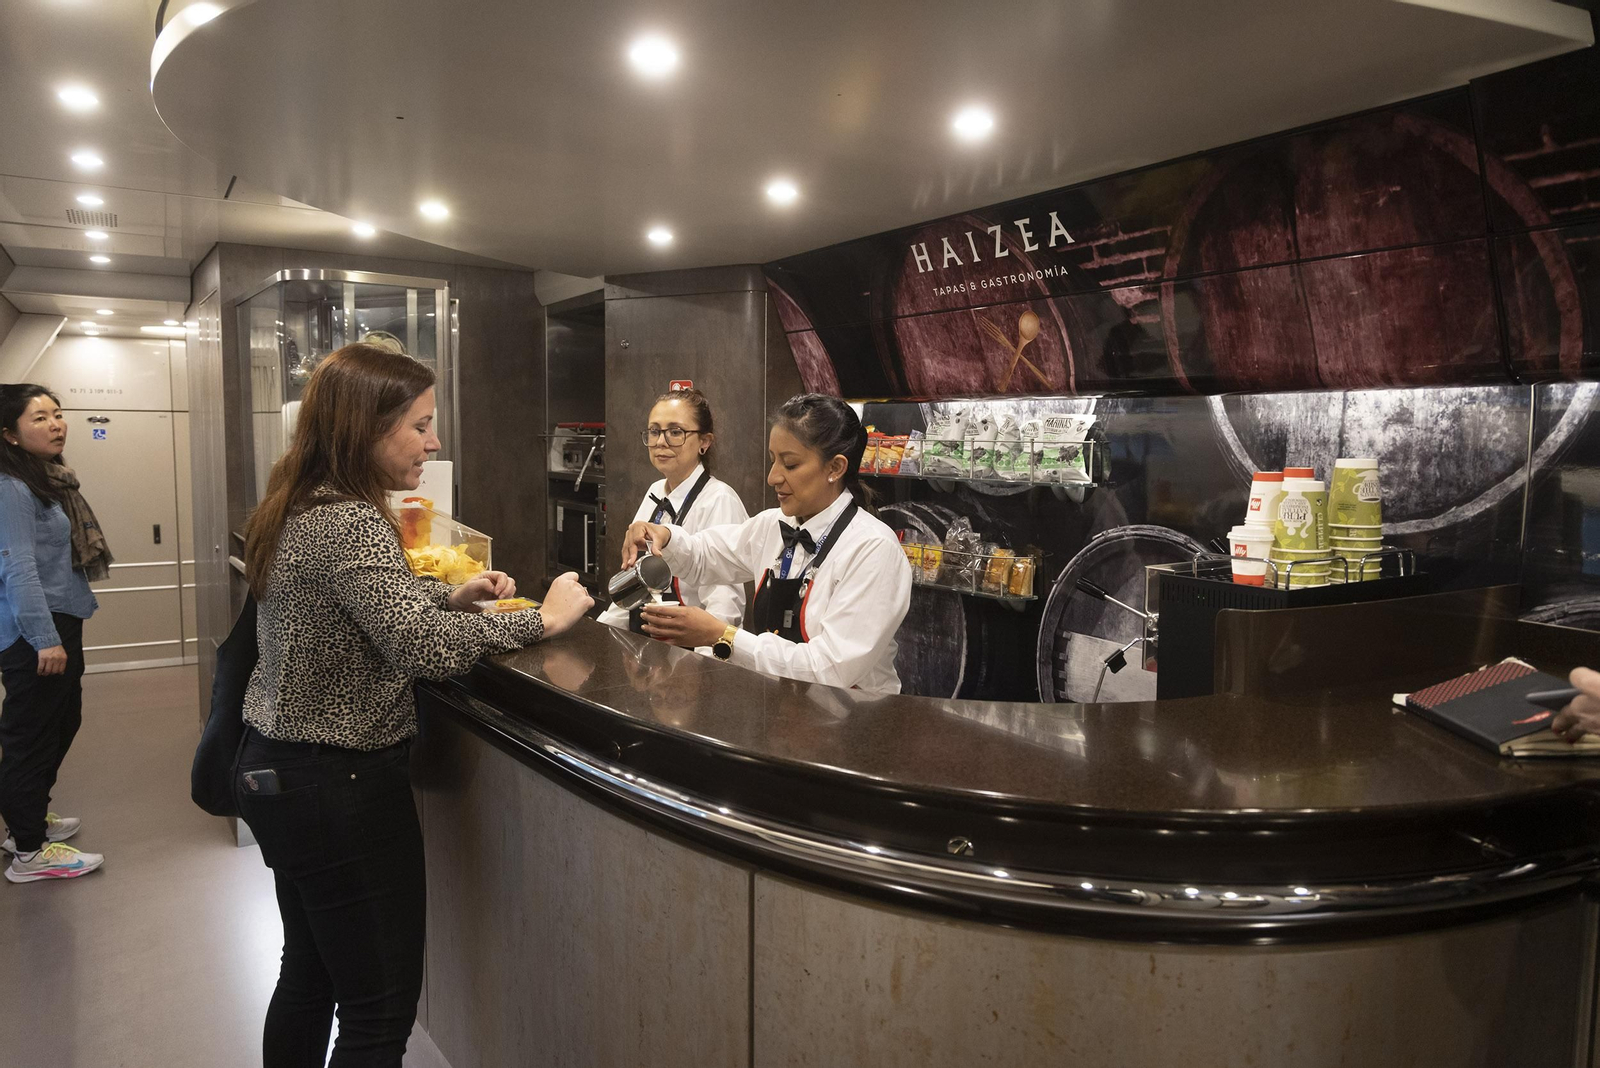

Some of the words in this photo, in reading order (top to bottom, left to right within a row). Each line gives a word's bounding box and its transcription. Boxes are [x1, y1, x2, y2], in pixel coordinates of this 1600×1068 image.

[910, 211, 1075, 273] HAIZEA
[933, 283, 966, 297] TAPAS
[980, 264, 1069, 289] GASTRONOMÍA
[1234, 546, 1247, 557] illy
